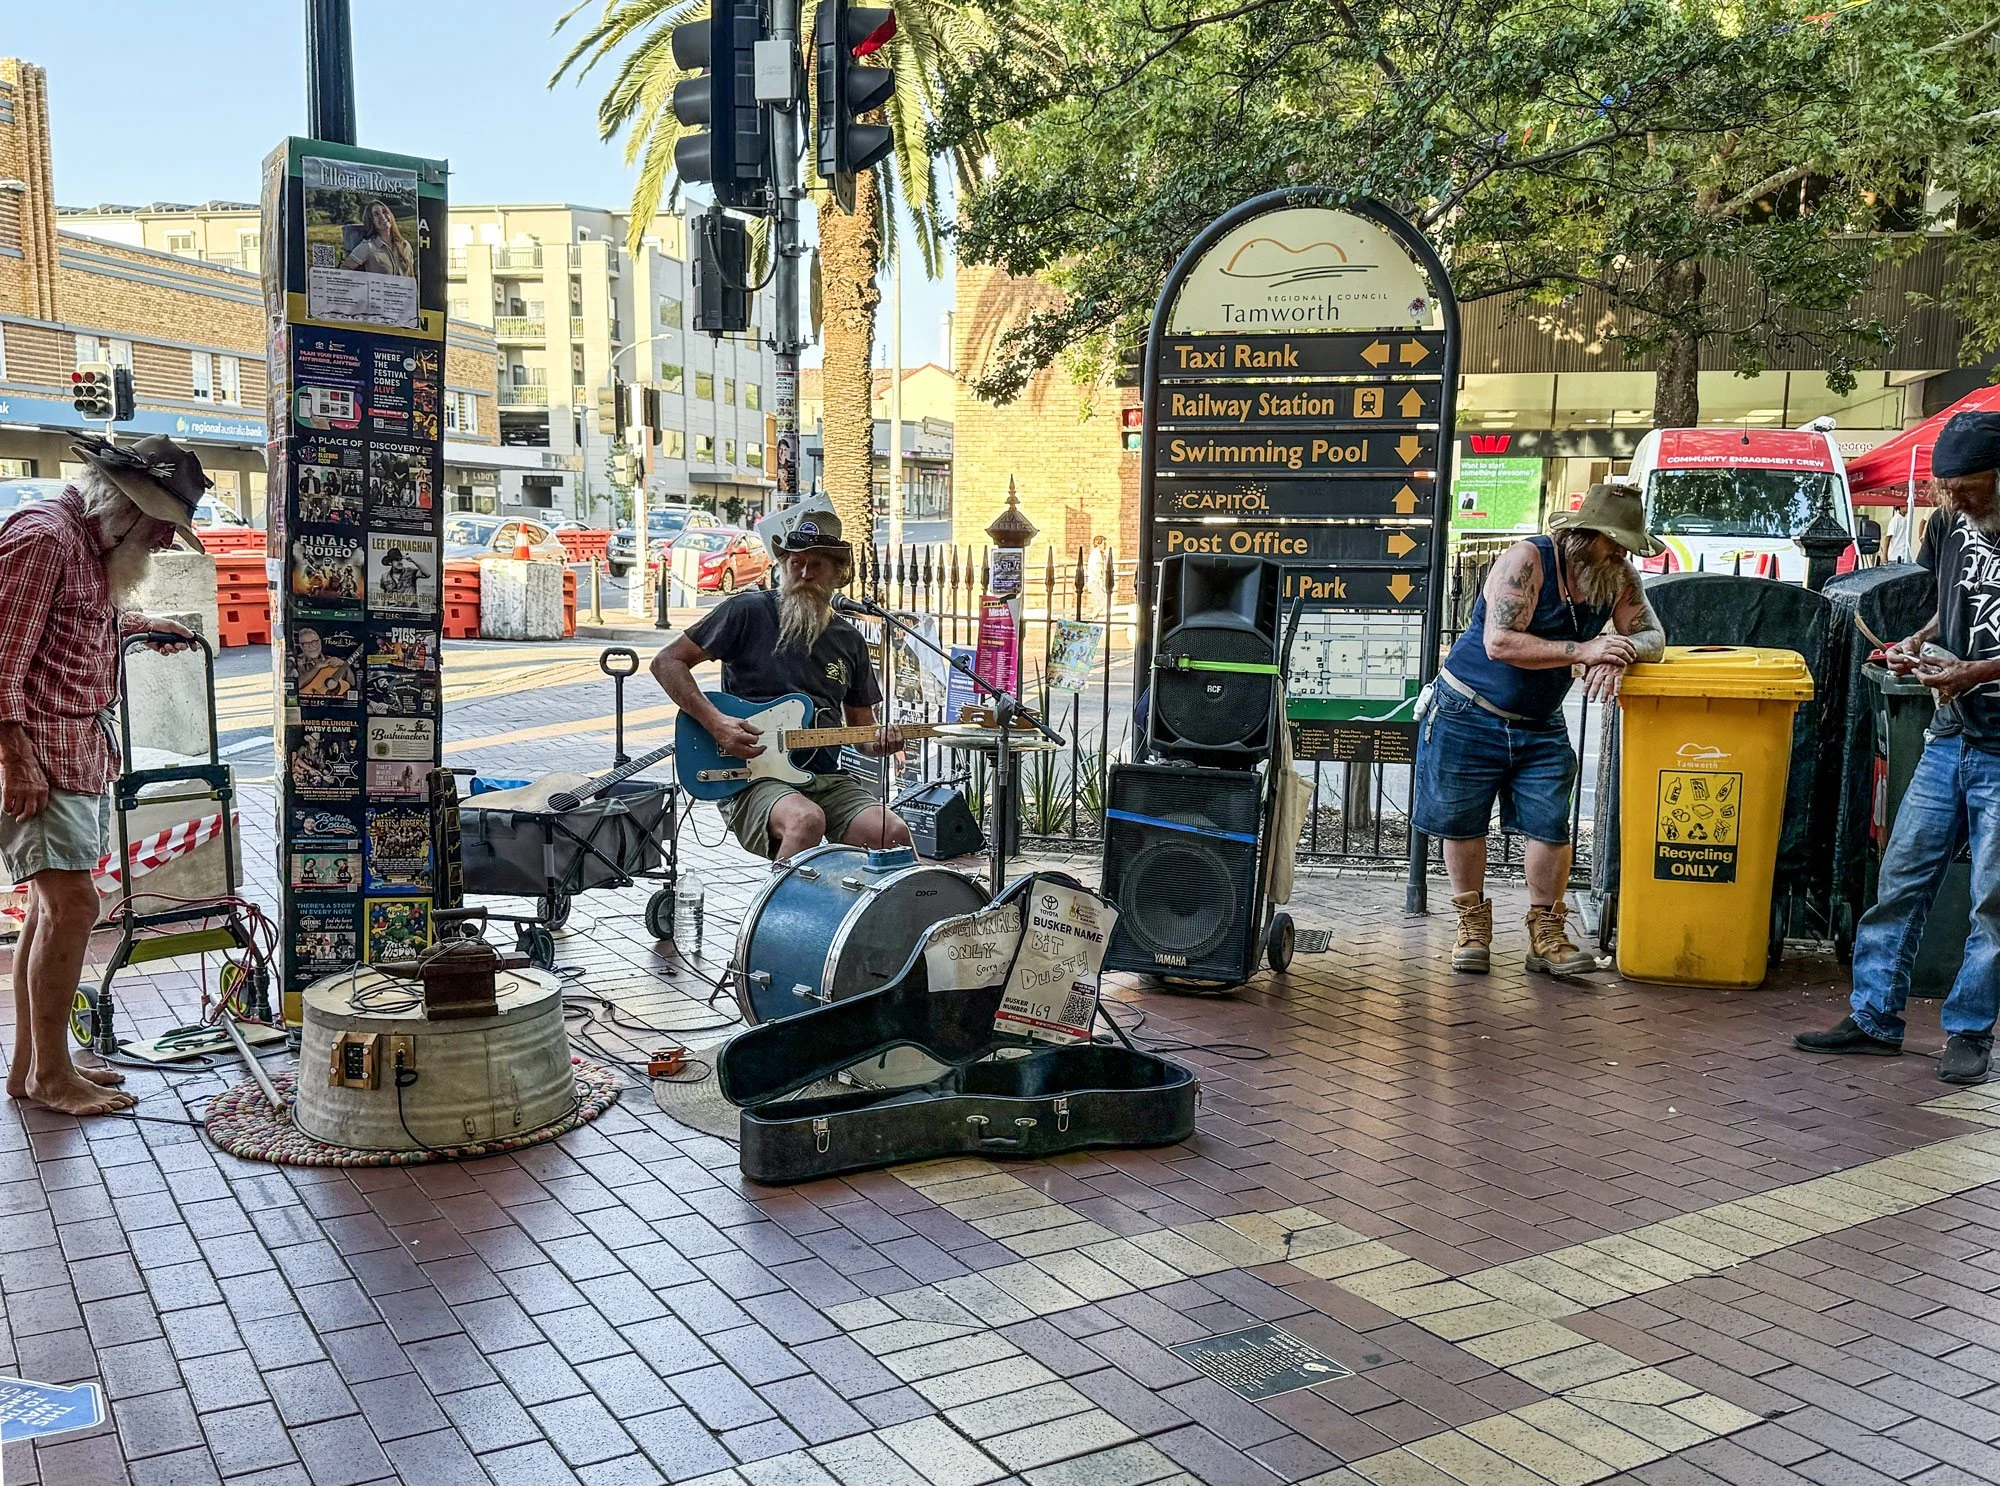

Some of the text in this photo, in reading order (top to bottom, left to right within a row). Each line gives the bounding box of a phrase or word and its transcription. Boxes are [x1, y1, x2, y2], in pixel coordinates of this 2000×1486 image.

[320, 166, 402, 193] Ellerie Rose
[1222, 295, 1339, 323] Tamworth
[374, 352, 400, 361] WHERE
[1175, 343, 1299, 369] Taxi Rank
[374, 369, 408, 379] FESTIVAL
[374, 377, 400, 386] COMES
[374, 386, 395, 394] ALIVE
[1171, 392, 1334, 423] Railway Station
[318, 437, 348, 446] PLACE
[370, 442, 420, 452] DISCOVERY
[1170, 439, 1368, 469] Swimming Pool
[1729, 456, 1795, 464] ENGAGEMENT
[1796, 459, 1824, 467] CREW
[1182, 489, 1269, 510] CAPITOL
[300, 535, 357, 548] FINALS
[372, 538, 432, 553] LEE KERNAGHAN
[1168, 530, 1308, 554] Post Office
[305, 546, 352, 558] RODEO
[1301, 576, 1347, 599] Park
[989, 608, 1009, 617] Music
[324, 638, 342, 646] Thank
[392, 628, 416, 643] PIGS
[1207, 685, 1222, 693] RCF
[372, 728, 429, 741] Bushwackers
[1676, 760, 1718, 769] Tamworth
[314, 820, 358, 832] Coaster
[376, 819, 396, 827] WESTS
[400, 819, 423, 828] DIGGERS
[1659, 845, 1733, 863] Recycling
[1671, 863, 1719, 878] ONLY
[1040, 909, 1058, 918] TOYOTA
[1033, 916, 1104, 944] BUSKER NAME
[381, 947, 417, 958] WISDOM
[948, 943, 996, 960] ONLY
[1154, 953, 1187, 967] YAMAHA
[976, 964, 997, 976] Sorry
[1003, 1003, 1028, 1013] NUMBER
[1005, 996, 1029, 1006] BUSKER
[1030, 1003, 1050, 1019] 169
[1268, 1337, 1293, 1353] Winners
[1276, 1334, 1322, 1360] Golden Guitar
[24, 1397, 48, 1407] TO
[17, 1404, 59, 1424] WAY
[31, 1407, 76, 1426] THIS
